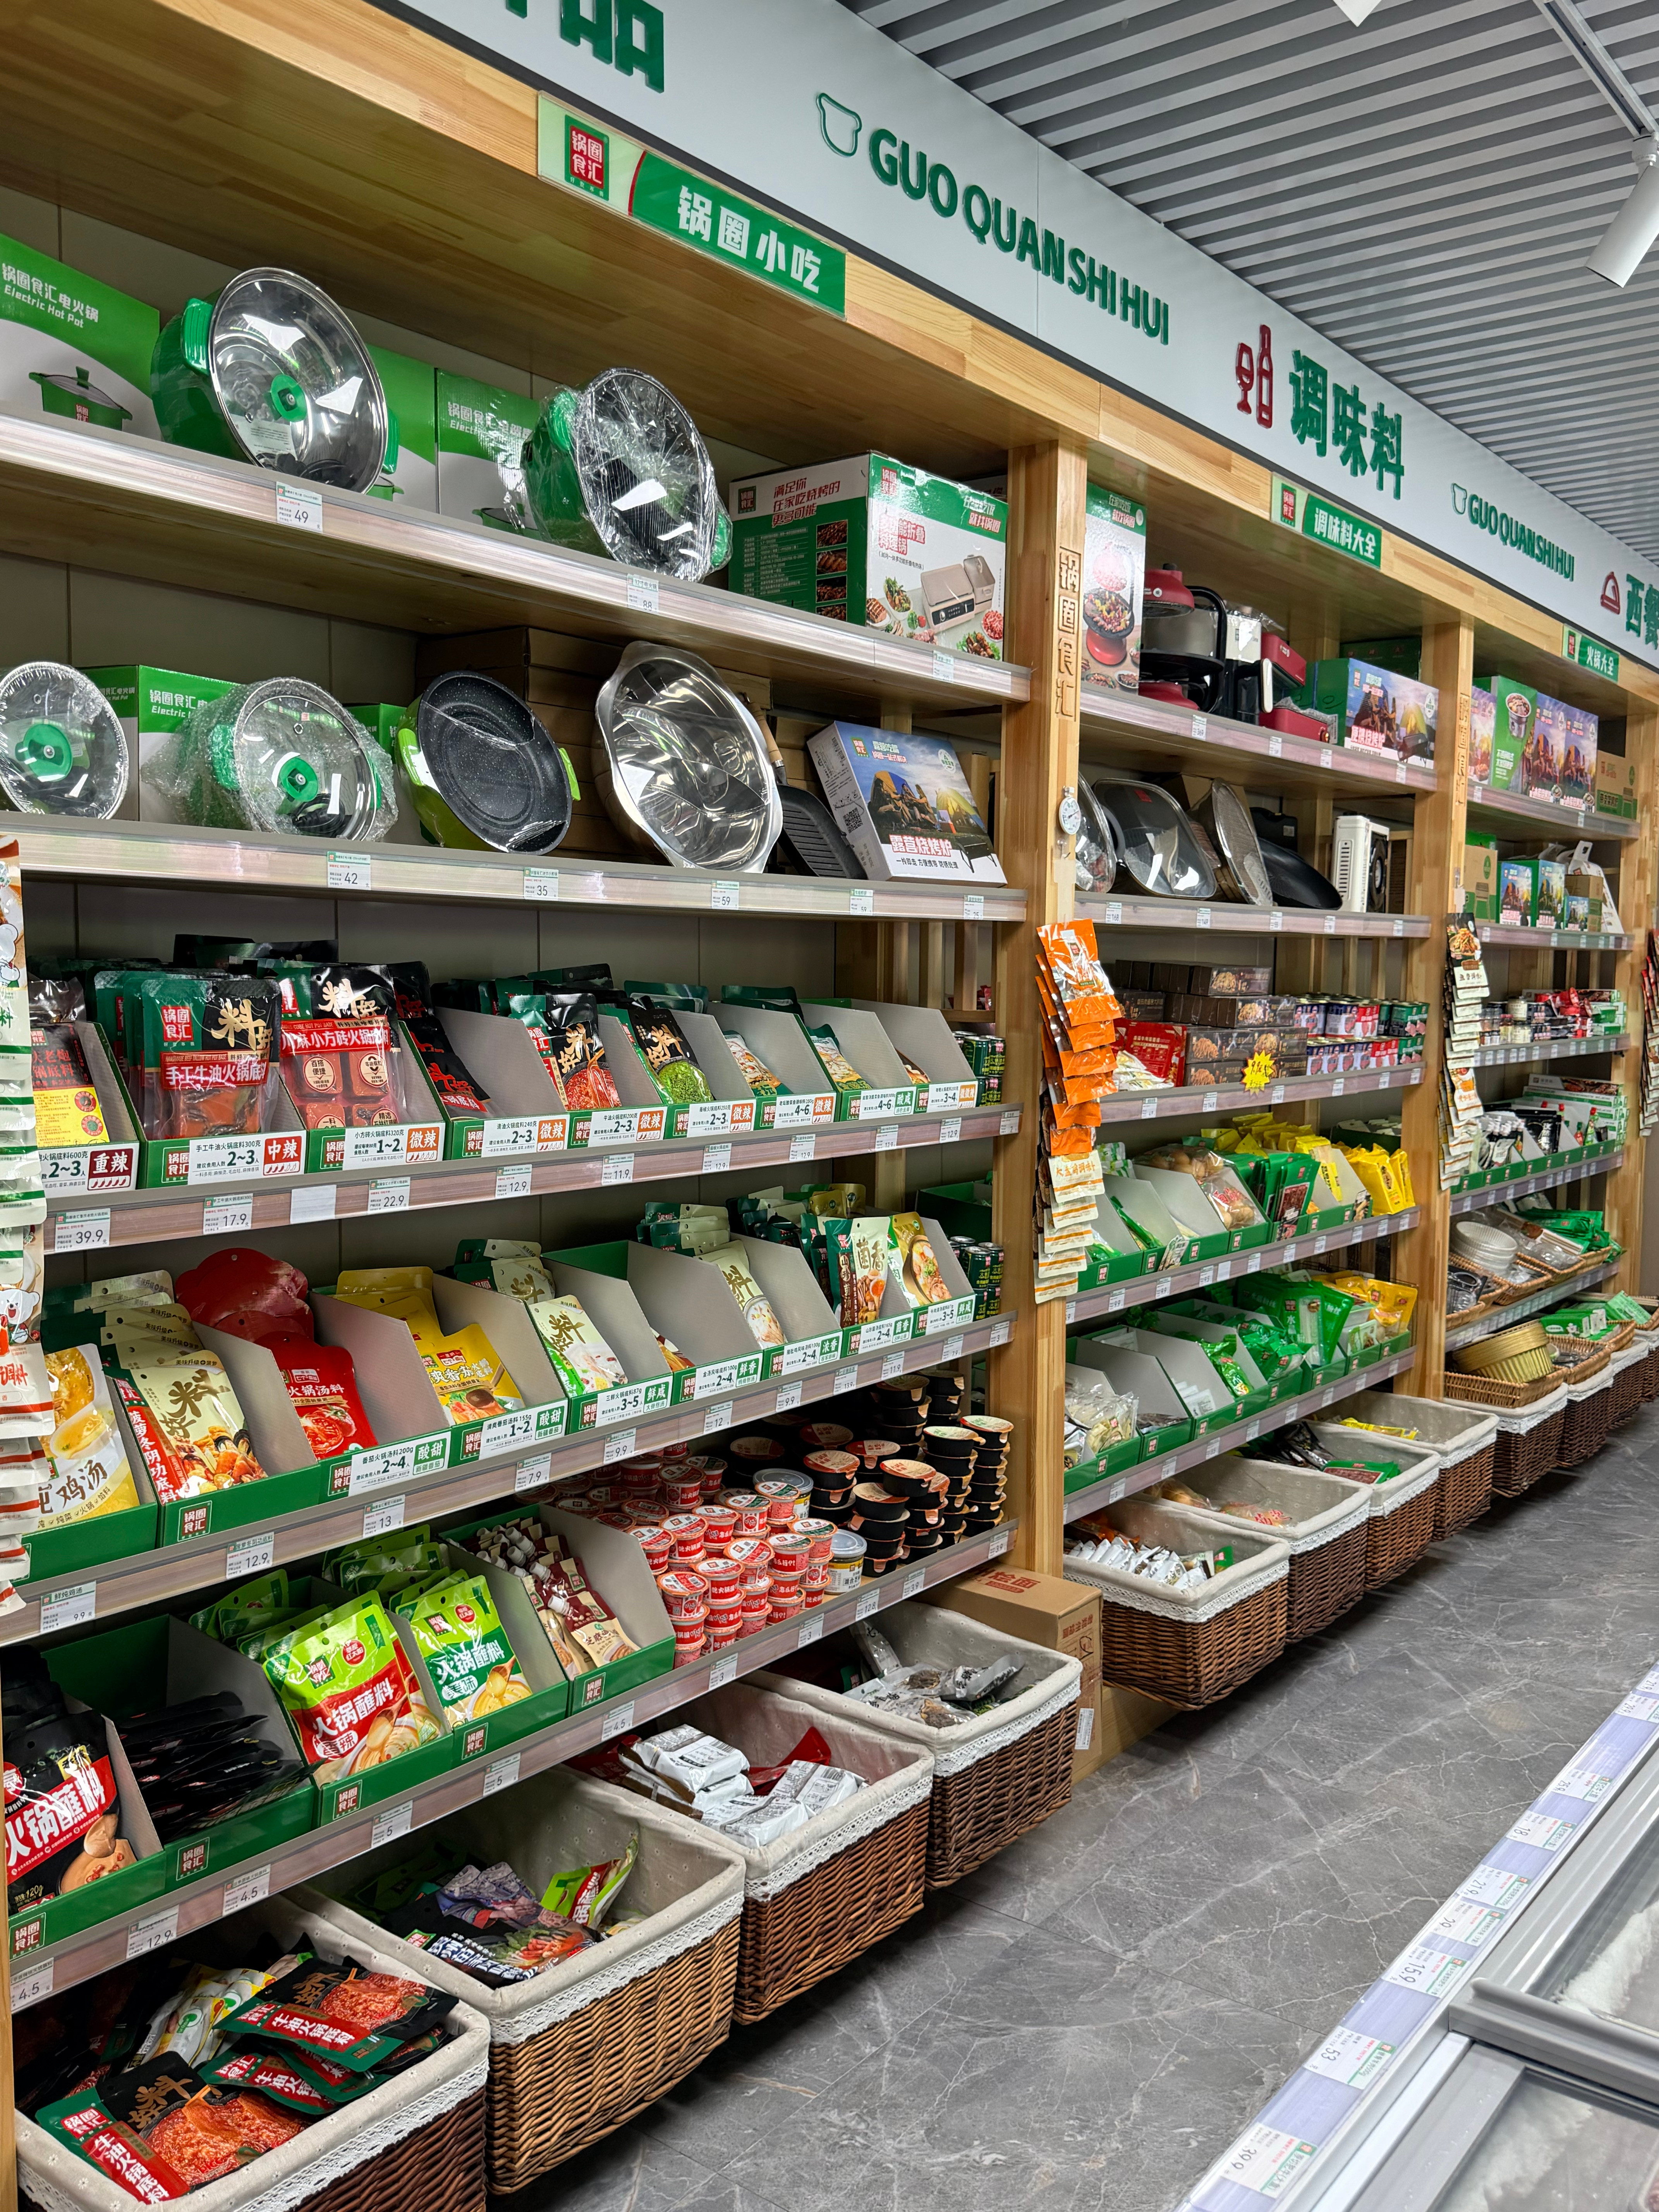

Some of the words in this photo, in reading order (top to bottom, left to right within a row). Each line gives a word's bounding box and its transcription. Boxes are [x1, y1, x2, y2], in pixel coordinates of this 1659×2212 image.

[571, 131, 603, 163] 锅圈
[570, 154, 603, 185] 食汇
[677, 186, 821, 293] 锅圈小吃
[4, 284, 45, 311] Electric
[47, 303, 65, 320] Hot
[67, 313, 84, 328] Pot
[1289, 350, 1404, 500] 调味料
[774, 477, 807, 499] 满足你
[773, 481, 841, 513] 在家吃烧烤的
[294, 510, 309, 524] 49
[772, 502, 817, 528] 更多可能
[1315, 508, 1375, 560] 调味料大全
[643, 601, 653, 611] 88
[1057, 552, 1080, 716] 锅圈食汇
[1587, 645, 1614, 676] 火锅大全
[151, 705, 185, 718] Electric
[889, 834, 953, 857] 露营烧烤炉
[345, 872, 358, 884] 42
[537, 885, 548, 896] 35
[721, 896, 731, 906] 59
[319, 978, 381, 1020] 料好
[164, 1009, 189, 1023] 锅圈
[166, 1024, 192, 1038] 食汇
[211, 999, 273, 1051] 料好
[166, 1062, 267, 1086] 手工牛油火锅底料
[878, 1099, 892, 1111] 4~6
[944, 1092, 956, 1103] 3~4
[732, 1105, 752, 1121] 微辣
[794, 1104, 810, 1116] 4~6
[815, 1098, 832, 1113] 微辣
[603, 1113, 638, 1121] 牛油火锅底料200克
[639, 1112, 661, 1129] 微辣
[710, 1113, 726, 1125] 2~3
[496, 1120, 537, 1130] 清油火锅底料240克
[539, 1121, 564, 1139] 微辣
[613, 1120, 632, 1133] 2~3
[355, 1129, 404, 1139] 小方砖火锅底料320克
[408, 1129, 437, 1149] 微辣
[511, 1130, 532, 1144] 2~3
[947, 1129, 957, 1139] 12.9
[196, 1140, 261, 1152] 手工牛油火锅底料300克
[268, 1139, 298, 1161] 中辣
[376, 1138, 400, 1153] 1~2
[93, 1151, 129, 1174] 重辣
[227, 1149, 255, 1166] 2~3
[49, 1160, 81, 1178] 2~3
[614, 1169, 629, 1180] 11.9
[510, 1181, 527, 1192] 12.9
[384, 1195, 405, 1207] 22.9
[223, 1213, 247, 1226] 17.9
[76, 1229, 103, 1244] 39.9
[857, 1237, 886, 1272] 菌香
[942, 1309, 954, 1322] 3~5
[877, 1328, 890, 1341] 2~4
[822, 1338, 838, 1353] 浓香
[802, 1349, 816, 1363] 2~4
[738, 1360, 757, 1377] 鲜香
[890, 1364, 901, 1374] 11.9
[716, 1372, 733, 1387] 2~4
[606, 1388, 642, 1401] 三鲜火锅底料87g
[647, 1384, 666, 1401] 鲜咸
[160, 1369, 230, 1438] 料好
[620, 1395, 639, 1411] 3~5
[785, 1396, 795, 1407] 9.9
[487, 1416, 519, 1431] 清爽番茄汤料
[539, 1408, 562, 1427] 酸甜
[714, 1417, 723, 1427] 12
[509, 1420, 531, 1437] 1~2
[129, 1410, 177, 1506] 菠萝冬阴功底料
[363, 1446, 414, 1465] 番茄火锅汤料200g
[418, 1442, 443, 1460] 酸甜
[615, 1445, 628, 1458] 9.9
[356, 1470, 381, 1481] 建议食用人数
[381, 1456, 406, 1474] 2~4
[529, 1471, 542, 1484] 7.9
[98, 1487, 112, 1501] 馅料
[79, 1501, 95, 1516] 火锅
[184, 1508, 206, 1522] 锅圈
[56, 1511, 72, 1525] 炖菜
[380, 1515, 392, 1528] 13
[184, 1519, 205, 1533] 食汇
[246, 1553, 269, 1568] 12.9
[54, 1587, 82, 1601] 鲜炖鸡汤
[910, 1582, 919, 1593] 3.9
[865, 1601, 876, 1614] 12.8
[74, 1611, 85, 1621] 9.9
[807, 1632, 812, 1640] 3
[436, 1640, 505, 1685] 火锅蘸料
[587, 1678, 602, 1692] 锅圈
[719, 1673, 724, 1682] 3
[587, 1687, 601, 1699] 食汇
[313, 1678, 395, 1739] 火锅蘸料
[613, 1718, 626, 1731] 4.5
[467, 1729, 484, 1743] 锅圈
[322, 1732, 356, 1756] 香辣
[467, 1739, 483, 1753] 食汇
[497, 1775, 503, 1786] 5
[1554, 1779, 1571, 1792] 25.9
[339, 1786, 357, 1802] 锅圈
[338, 1798, 357, 1812] 食汇
[5, 1767, 106, 1867] 火锅蘸料
[386, 1826, 393, 1836] 5
[1514, 1826, 1531, 1836] 18
[183, 1845, 204, 1860] 锅圈
[182, 1855, 204, 1870] 食汇
[240, 1886, 258, 1902] 4.5
[1467, 1879, 1487, 1895] 21.9
[15, 1921, 40, 1939] 锅圈
[15, 1932, 39, 1951] 食汇
[147, 1930, 172, 1949] 12.9
[1398, 1962, 1425, 1984] 15.9
[19, 1982, 40, 2001] 4.5
[271, 2013, 355, 2045] 牛油火锅底料
[1321, 2045, 1341, 2063] 53
[127, 2075, 193, 2129] 料好
[1230, 2146, 1258, 2170] 39.9
[93, 2132, 170, 2205] 牛油火锅底料
